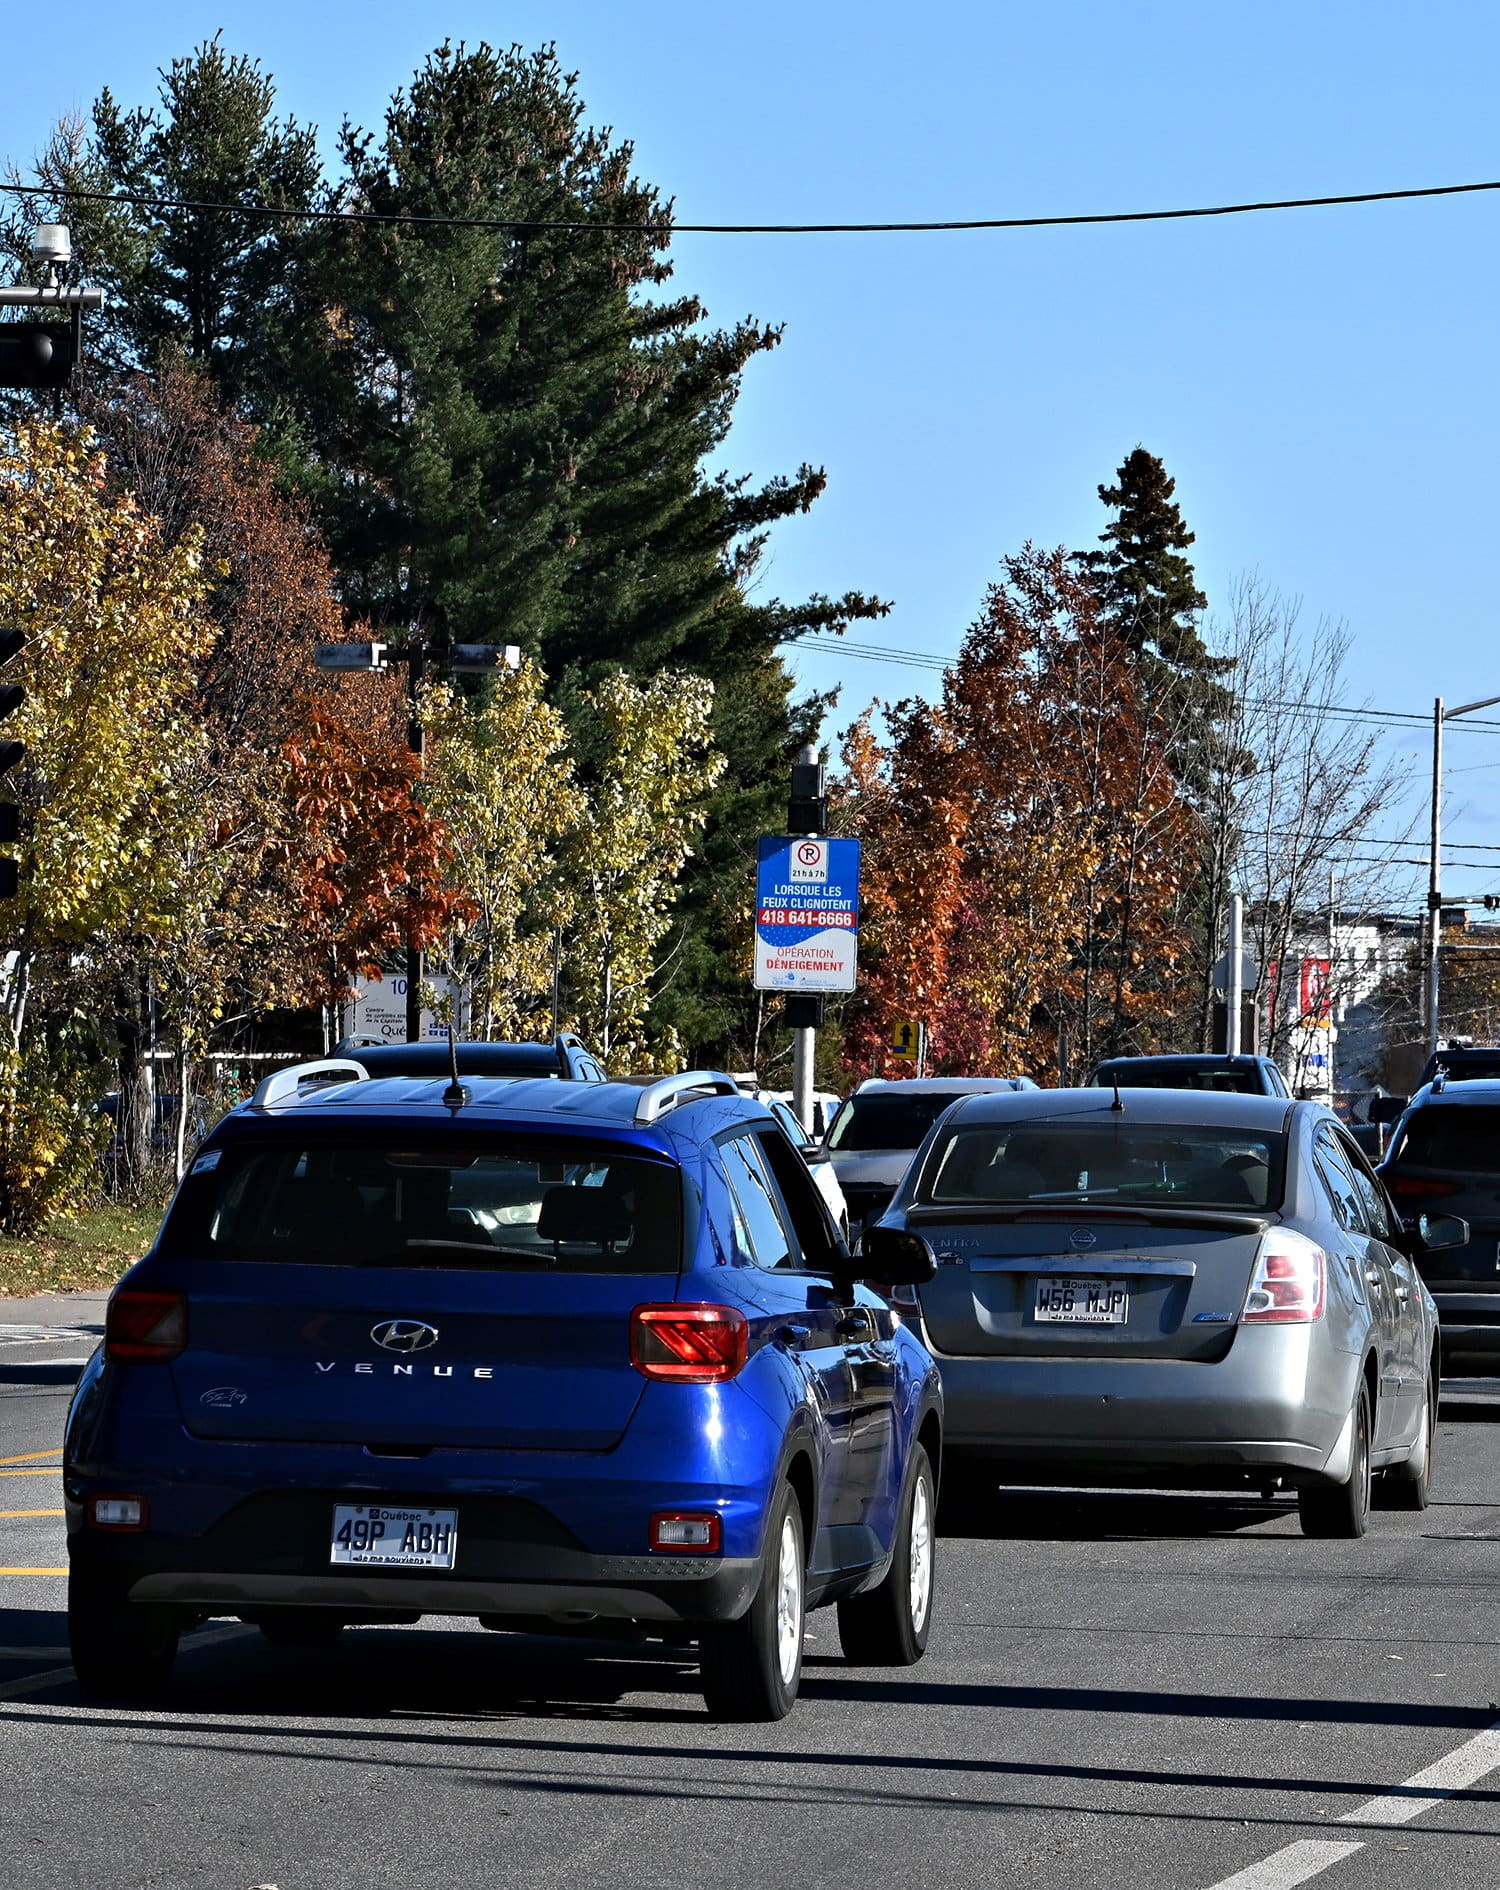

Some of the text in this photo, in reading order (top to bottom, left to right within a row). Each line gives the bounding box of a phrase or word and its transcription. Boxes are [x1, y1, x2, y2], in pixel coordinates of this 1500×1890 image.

[774, 884, 842, 897] LORSQUE LES
[763, 897, 852, 910] FEUX CLIGNOTENT
[762, 910, 852, 926] 418 641-6666
[777, 946, 834, 959] OPÉRATION
[766, 957, 844, 971] DÉNEIGEMENT
[931, 1239, 980, 1248] ENTRA
[1070, 1280, 1102, 1290] Québec
[1038, 1288, 1124, 1313] W56 MJP
[315, 1361, 494, 1379] VENUE
[381, 1510, 421, 1521] Québec
[336, 1519, 451, 1554] 49P ABH
